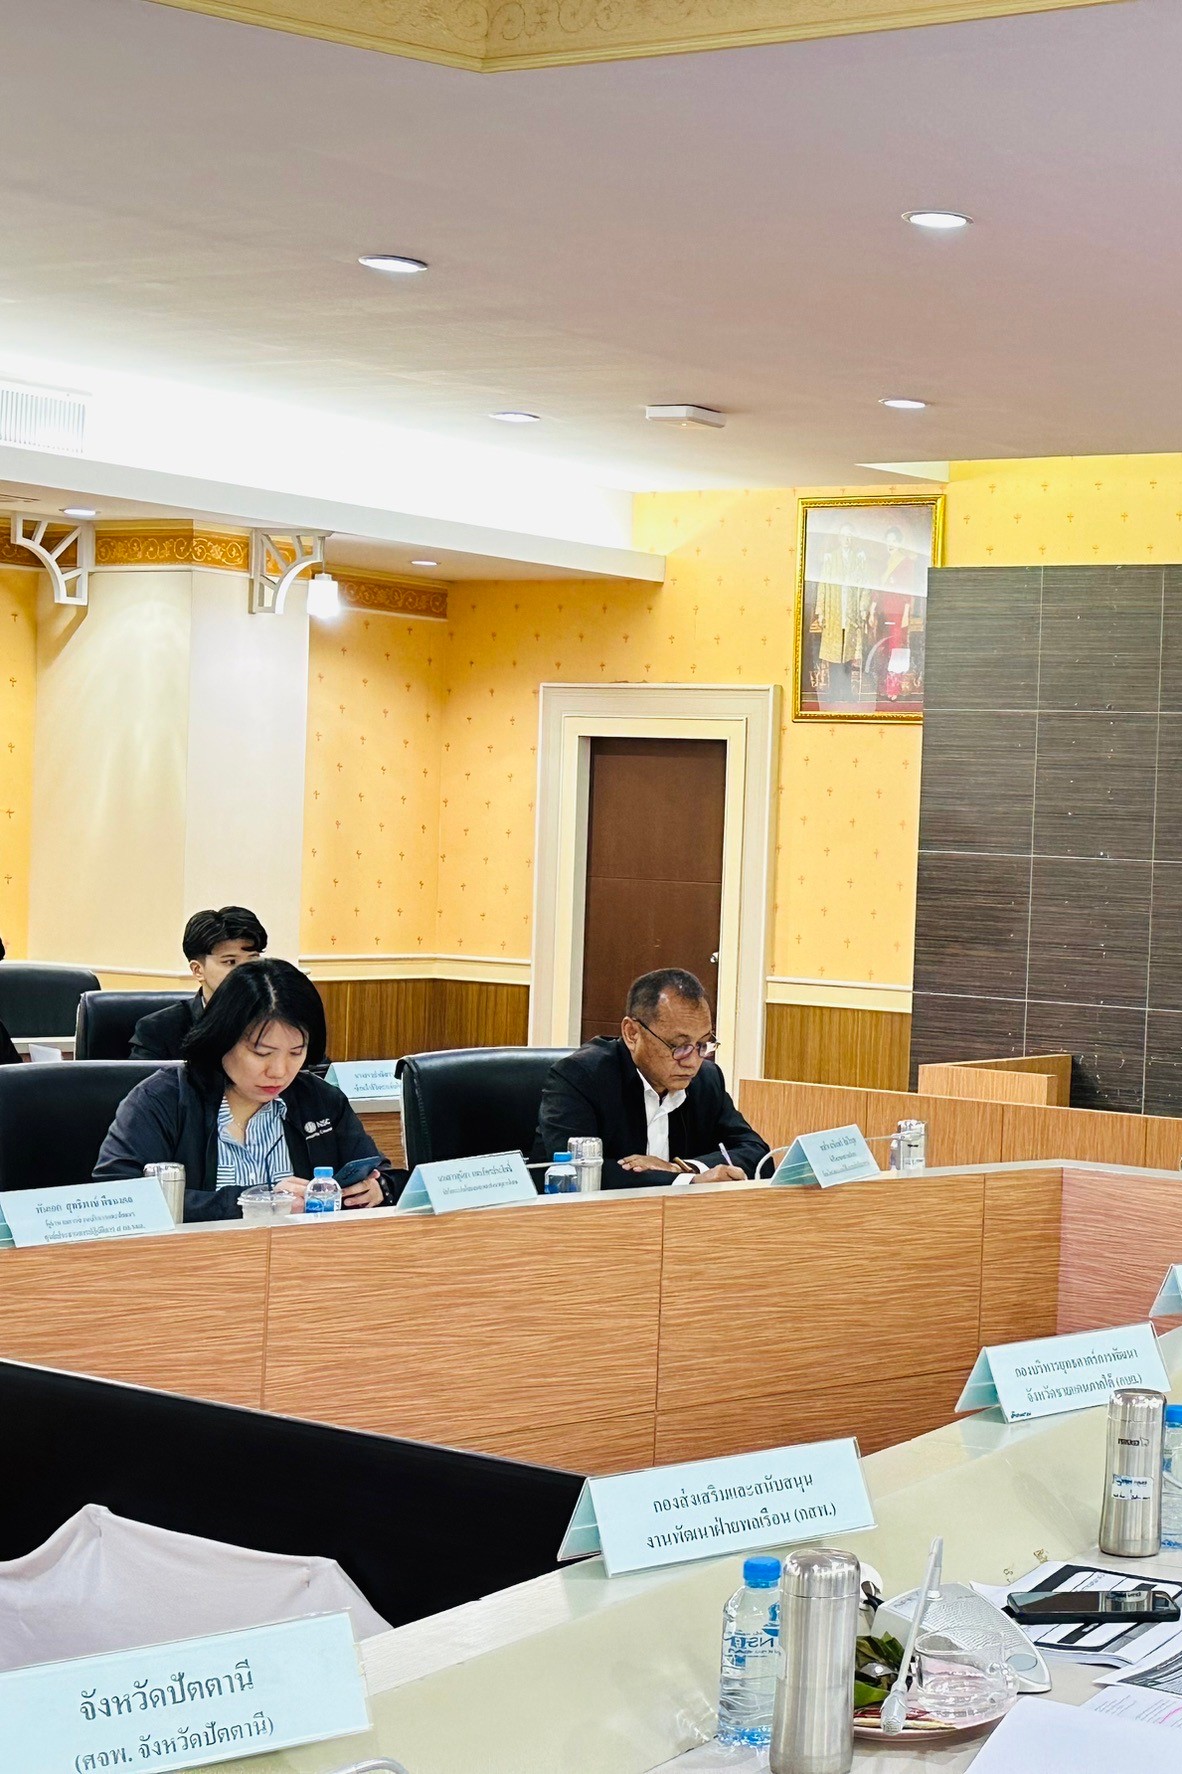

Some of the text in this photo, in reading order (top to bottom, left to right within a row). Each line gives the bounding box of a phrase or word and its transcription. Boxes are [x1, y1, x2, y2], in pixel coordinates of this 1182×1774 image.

[653, 1473, 813, 1514] กองส่งเสริมและสนับสนุน
[646, 1506, 791, 1549] งานพัฒนาฝ่ายพลเรือน
[79, 1658, 254, 1722] จังหวัดปัตตานี
[138, 1710, 274, 1759] จังหวัดปัตตานี)
